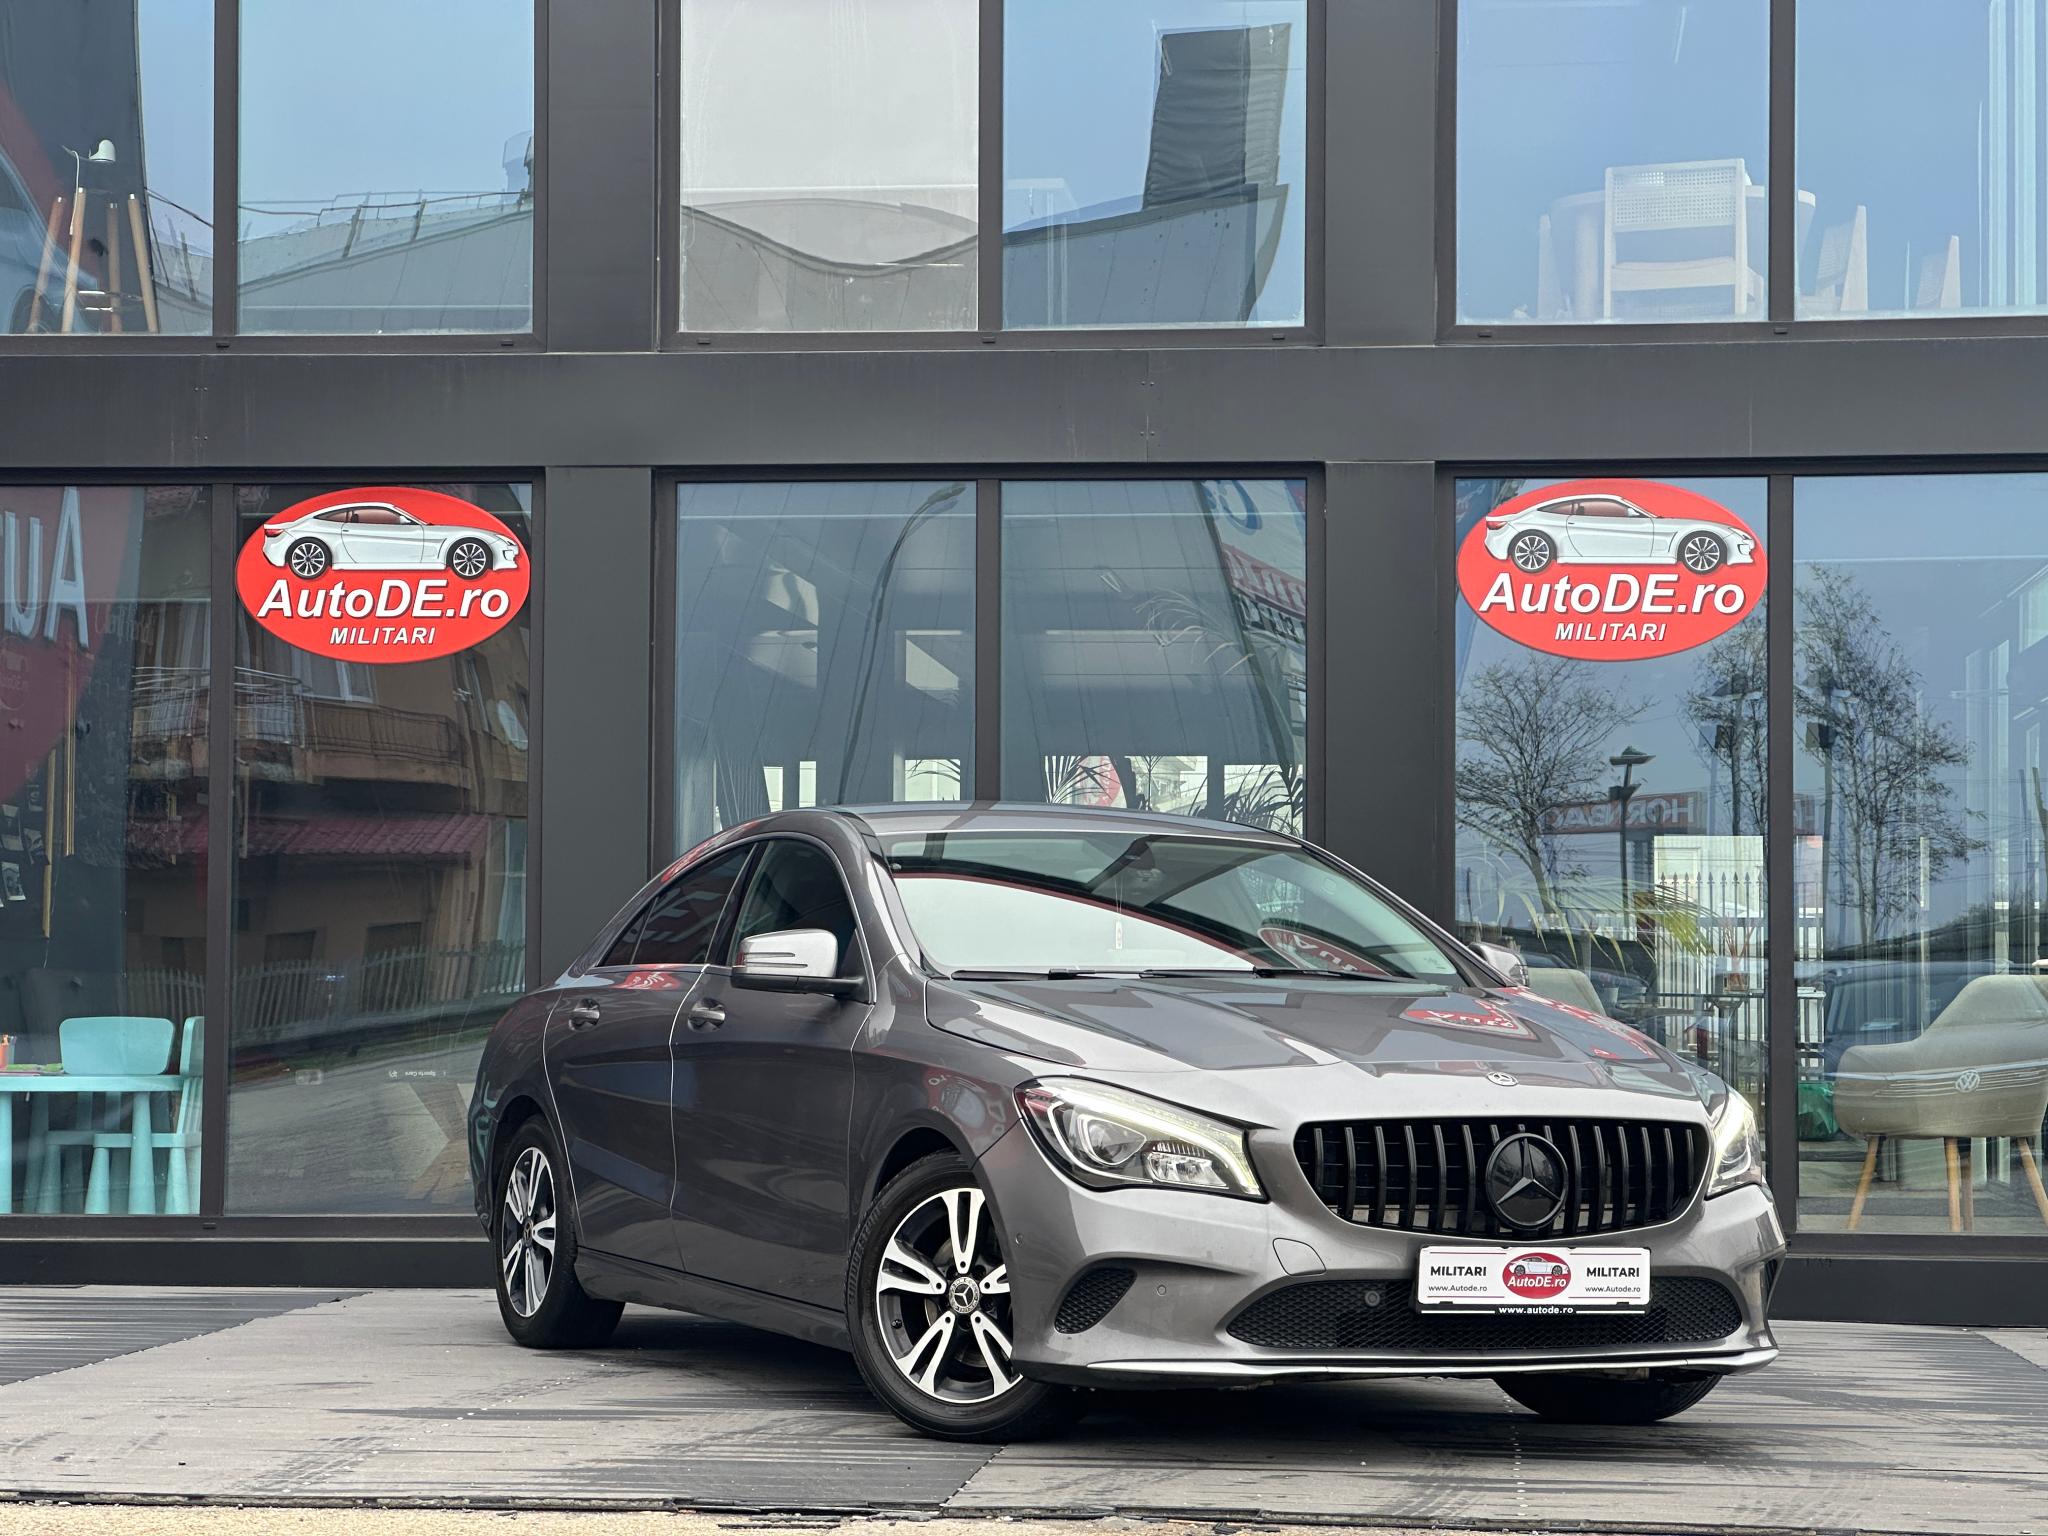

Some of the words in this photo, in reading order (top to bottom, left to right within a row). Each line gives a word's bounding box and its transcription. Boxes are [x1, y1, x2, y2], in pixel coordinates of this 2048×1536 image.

[257, 579, 510, 618] AutoDE.ro
[1479, 573, 1745, 613] AutoDE.ro
[330, 627, 435, 645] MILITARI
[1554, 623, 1667, 641] MILITARI
[1430, 1266, 1487, 1277] MILITARI
[1586, 1267, 1640, 1278] MILITARI
[1507, 1275, 1567, 1289] AutoDE.ro
[1428, 1284, 1488, 1293] www.Autode.ro
[1584, 1285, 1641, 1293] www.Autode.ro
[1498, 1306, 1574, 1315] www.autode.ro
